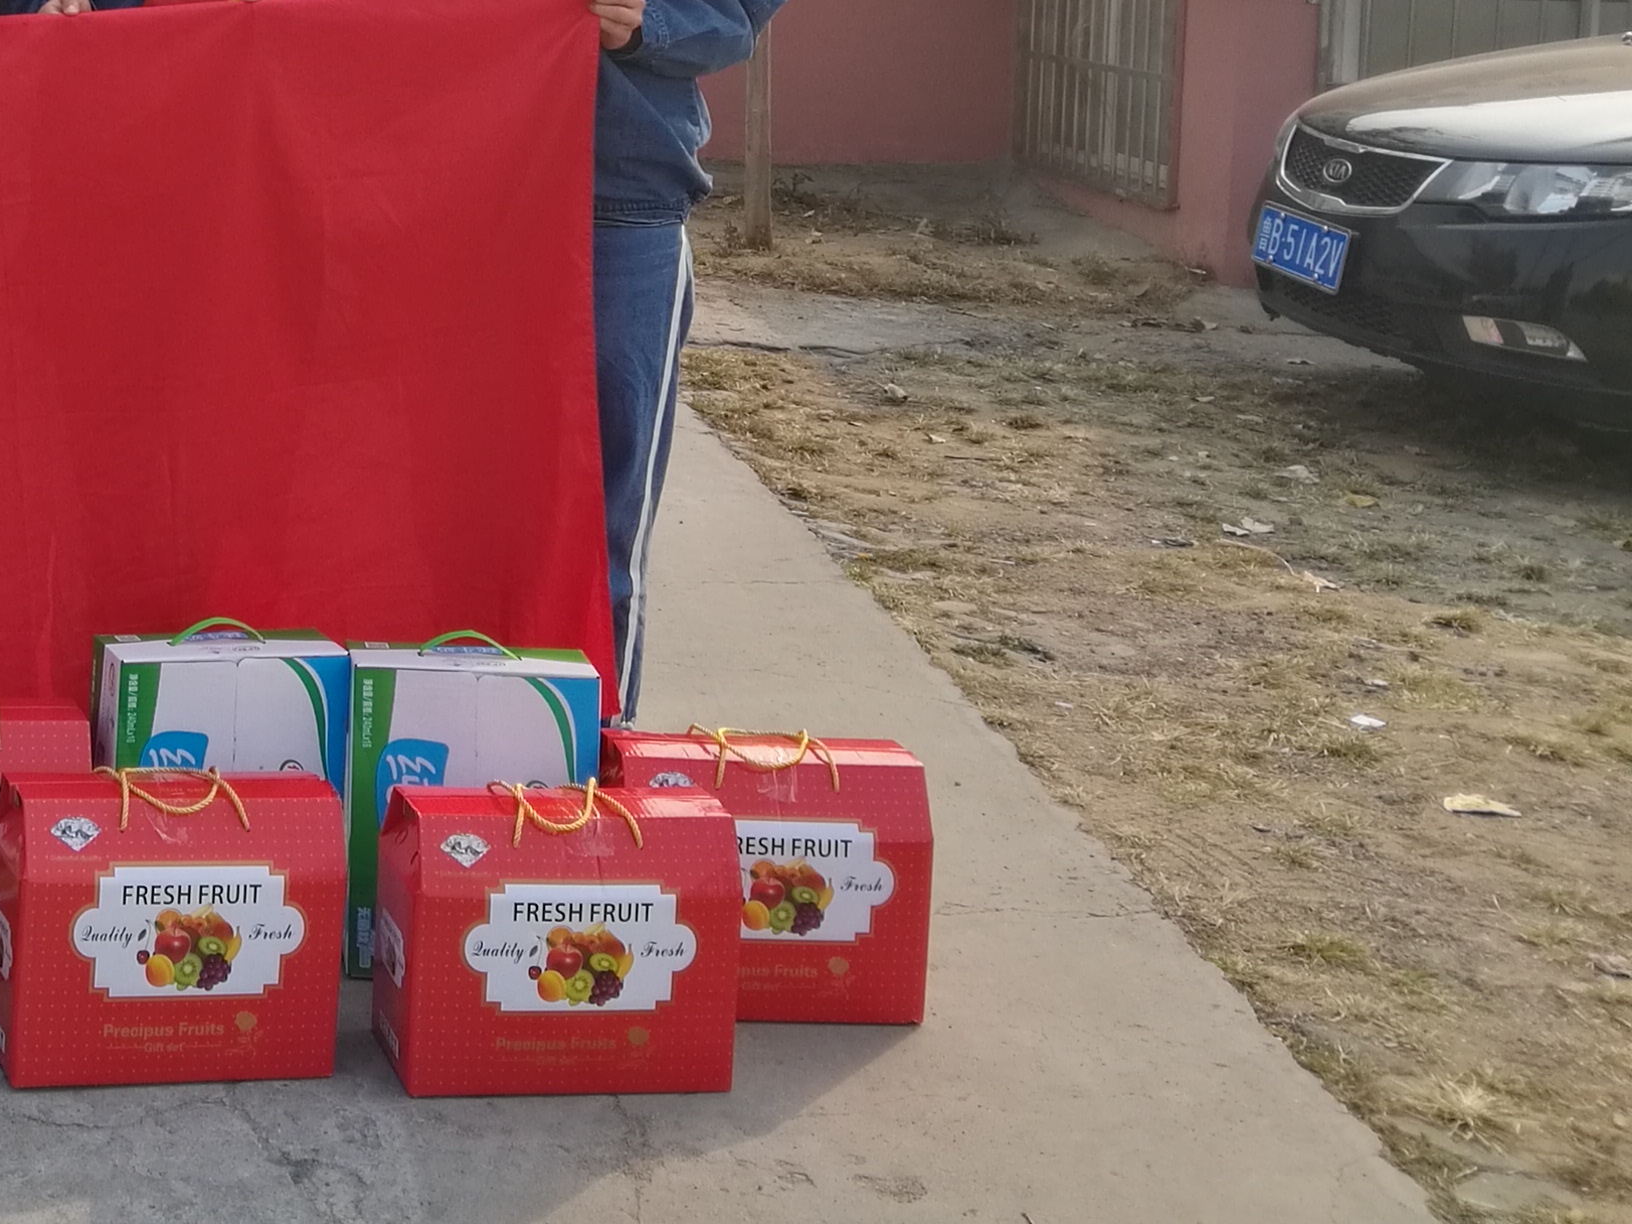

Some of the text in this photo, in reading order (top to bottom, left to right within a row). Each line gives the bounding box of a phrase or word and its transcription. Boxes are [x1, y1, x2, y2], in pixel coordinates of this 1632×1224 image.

[736, 837, 853, 858] RESH FRUIT
[122, 884, 262, 905] FRESH FRUIT
[840, 876, 883, 892] Fresh
[513, 902, 654, 923] FRESH FRUIT
[80, 925, 133, 949] Quality
[248, 924, 296, 941] Fresh
[471, 940, 524, 964] Quality
[640, 941, 687, 958] Fresh
[178, 1022, 224, 1036] Fruits
